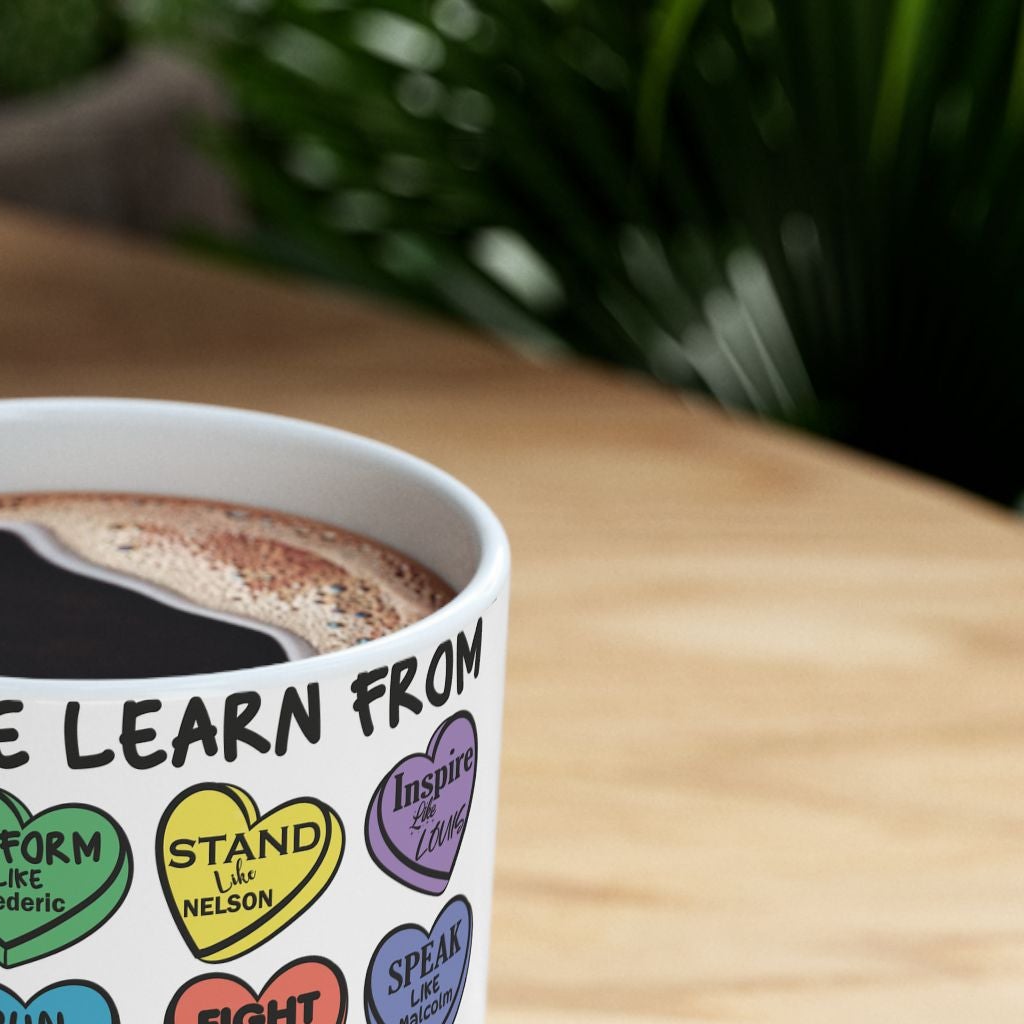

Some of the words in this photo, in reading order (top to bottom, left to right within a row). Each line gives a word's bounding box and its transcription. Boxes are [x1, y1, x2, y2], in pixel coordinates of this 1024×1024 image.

[64, 682, 321, 770] LEARN
[350, 617, 483, 737] FROM
[393, 747, 474, 813] Inspire
[168, 822, 321, 869] STAND
[214, 859, 256, 893] Like
[183, 889, 273, 918] NELSON
[388, 920, 462, 995] SPEAK
[410, 975, 440, 1007] LIKE
